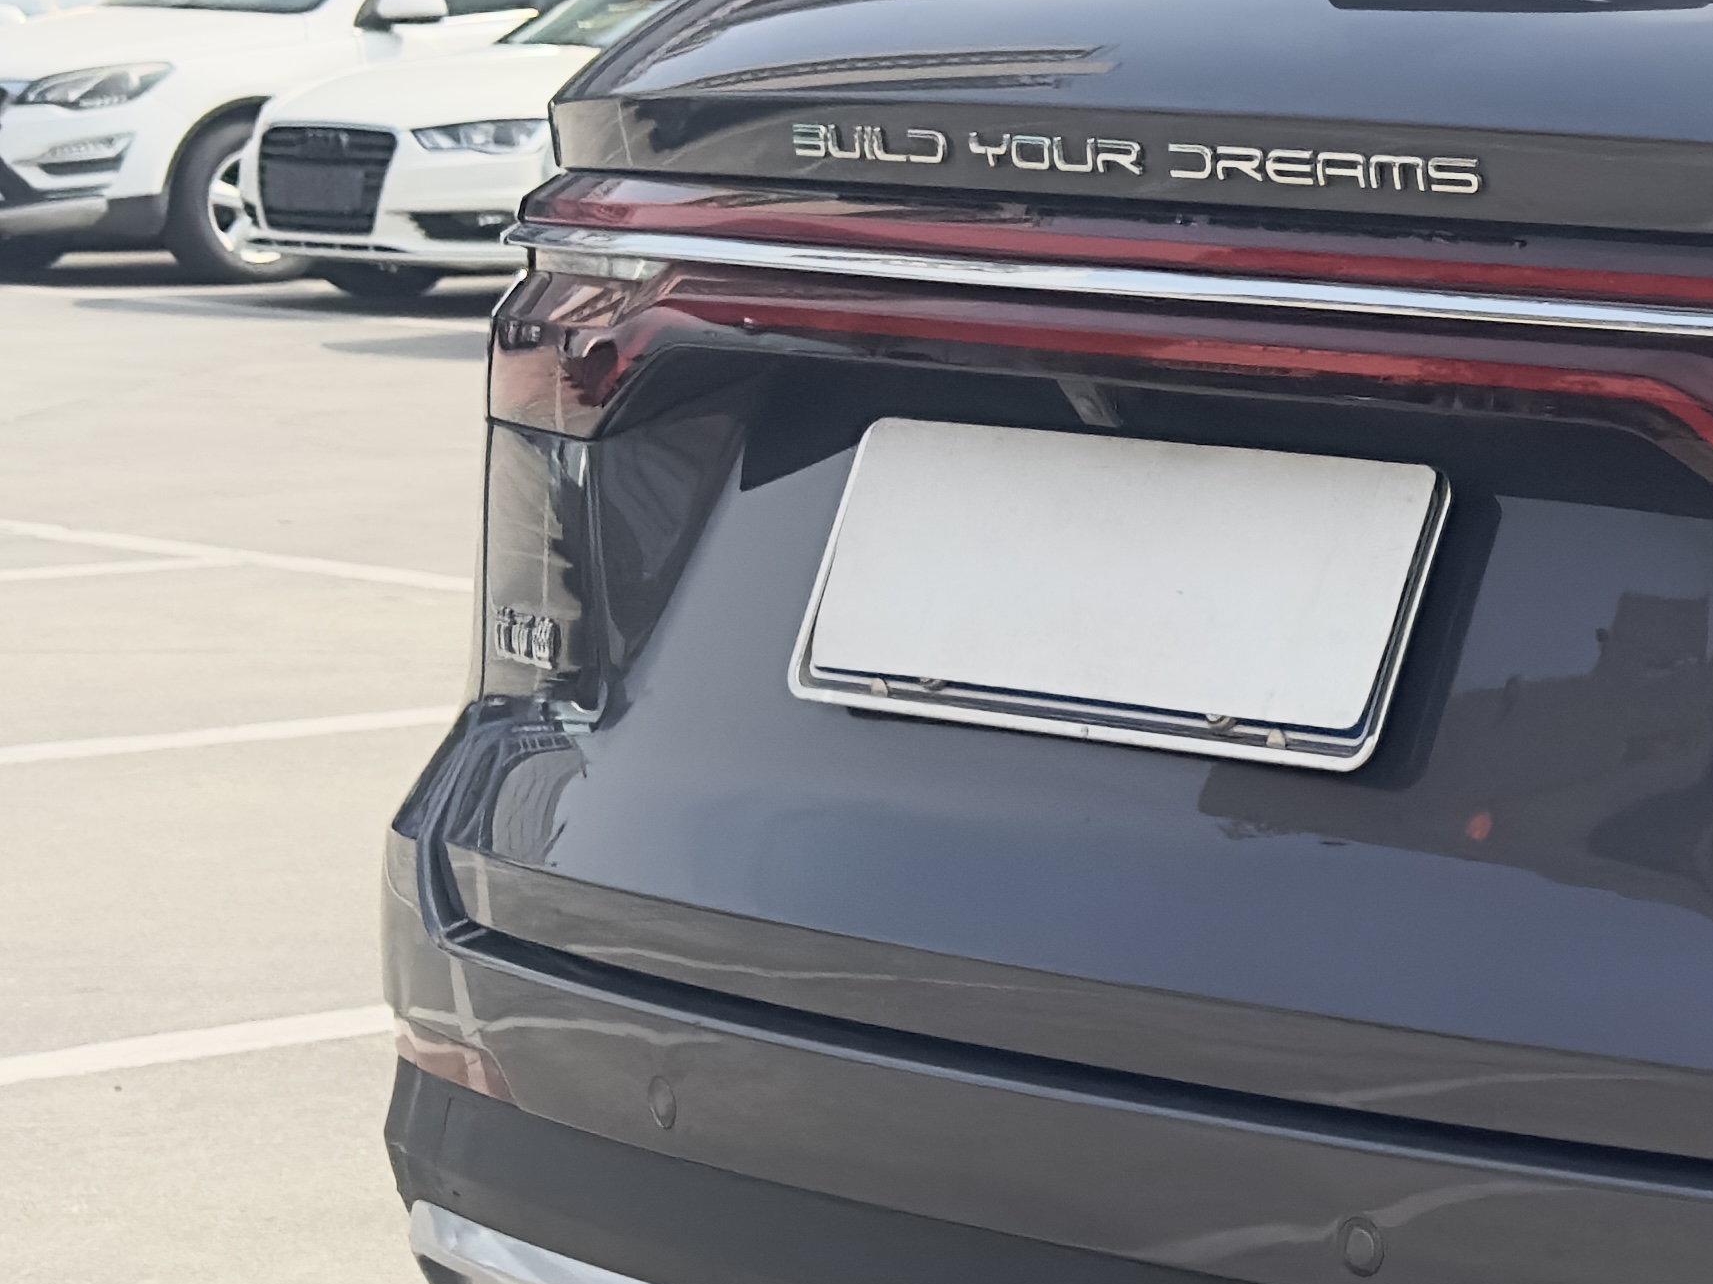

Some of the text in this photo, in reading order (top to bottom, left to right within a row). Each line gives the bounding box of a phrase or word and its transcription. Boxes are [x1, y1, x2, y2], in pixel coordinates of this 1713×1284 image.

[792, 123, 1481, 194] BUILD YOUR DREAMS
